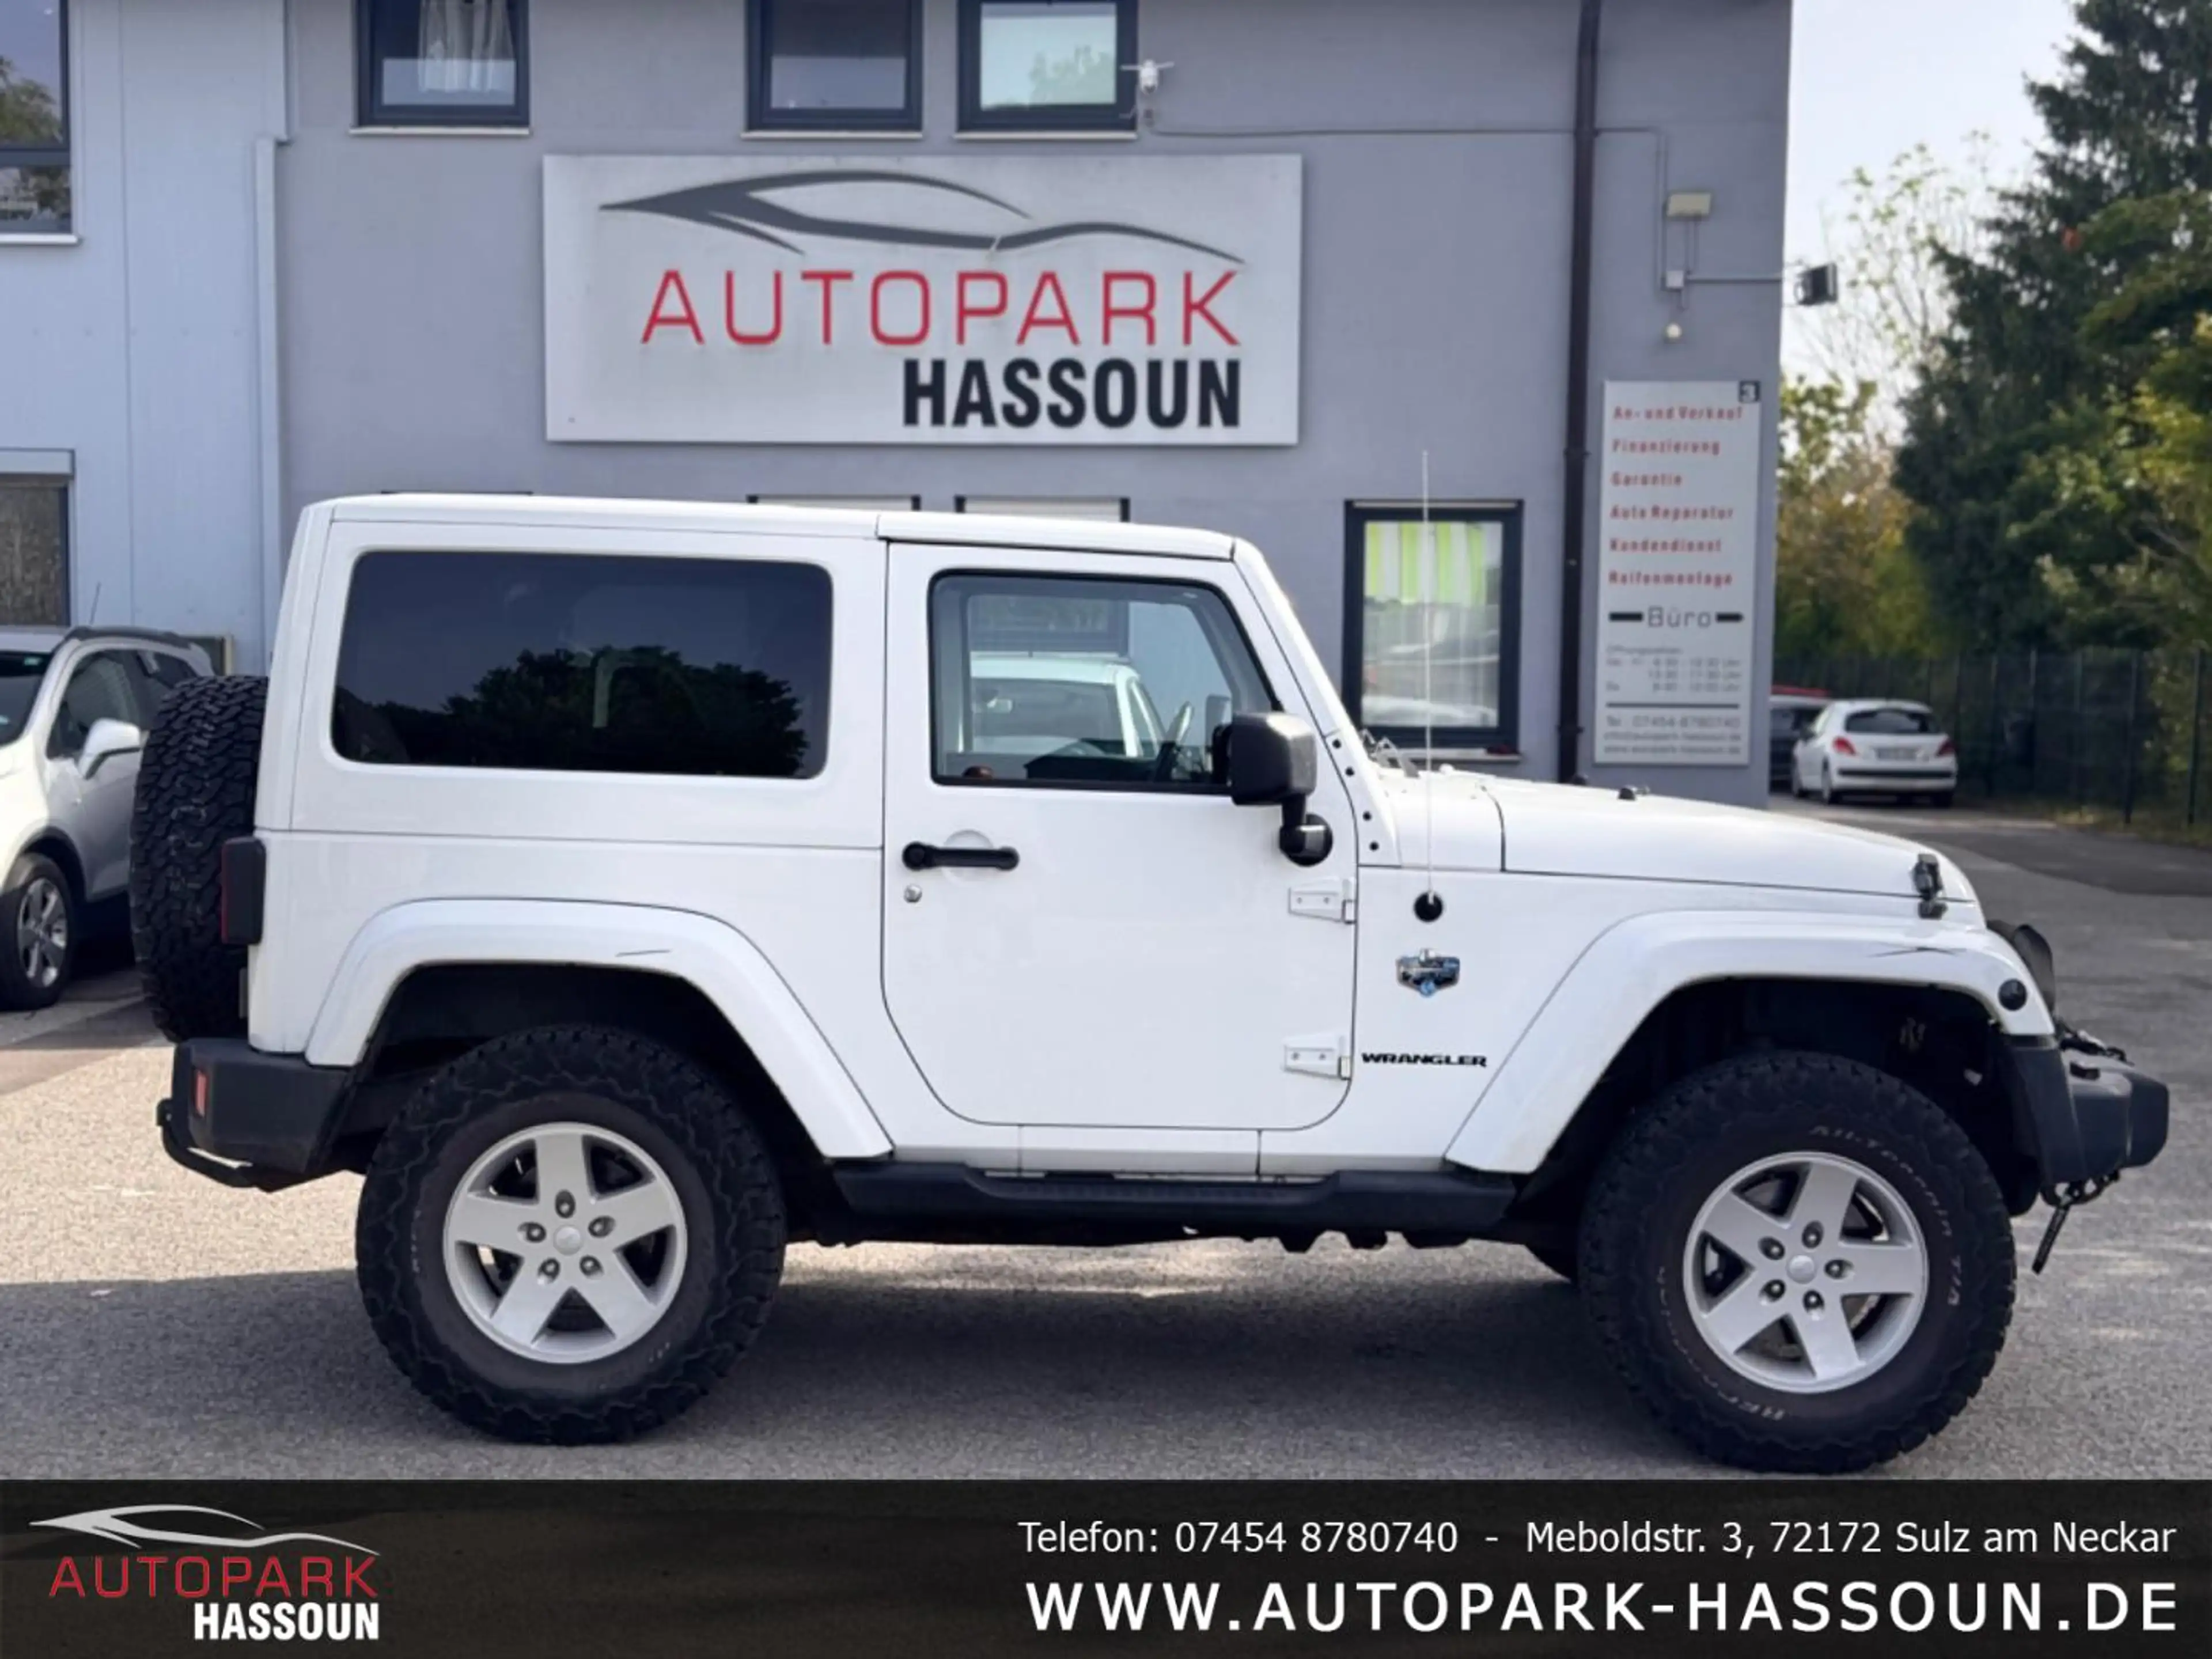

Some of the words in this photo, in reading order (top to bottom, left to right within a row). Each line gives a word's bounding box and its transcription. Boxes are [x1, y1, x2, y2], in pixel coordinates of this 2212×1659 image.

[641, 268, 1239, 346] AUTOPARK
[903, 358, 1240, 429] HASSOUN
[1645, 407, 1674, 420] und
[1678, 406, 1743, 420] Verkauf
[1612, 438, 1721, 456] Finanzierung
[1611, 471, 1683, 487] Garantie
[1611, 505, 1647, 520] Auto
[1610, 537, 1722, 552] Kundendienst
[1609, 569, 1733, 588] Reifenmontage
[1647, 606, 1711, 627] Büro
[1361, 1052, 1487, 1067] WRANGLER
